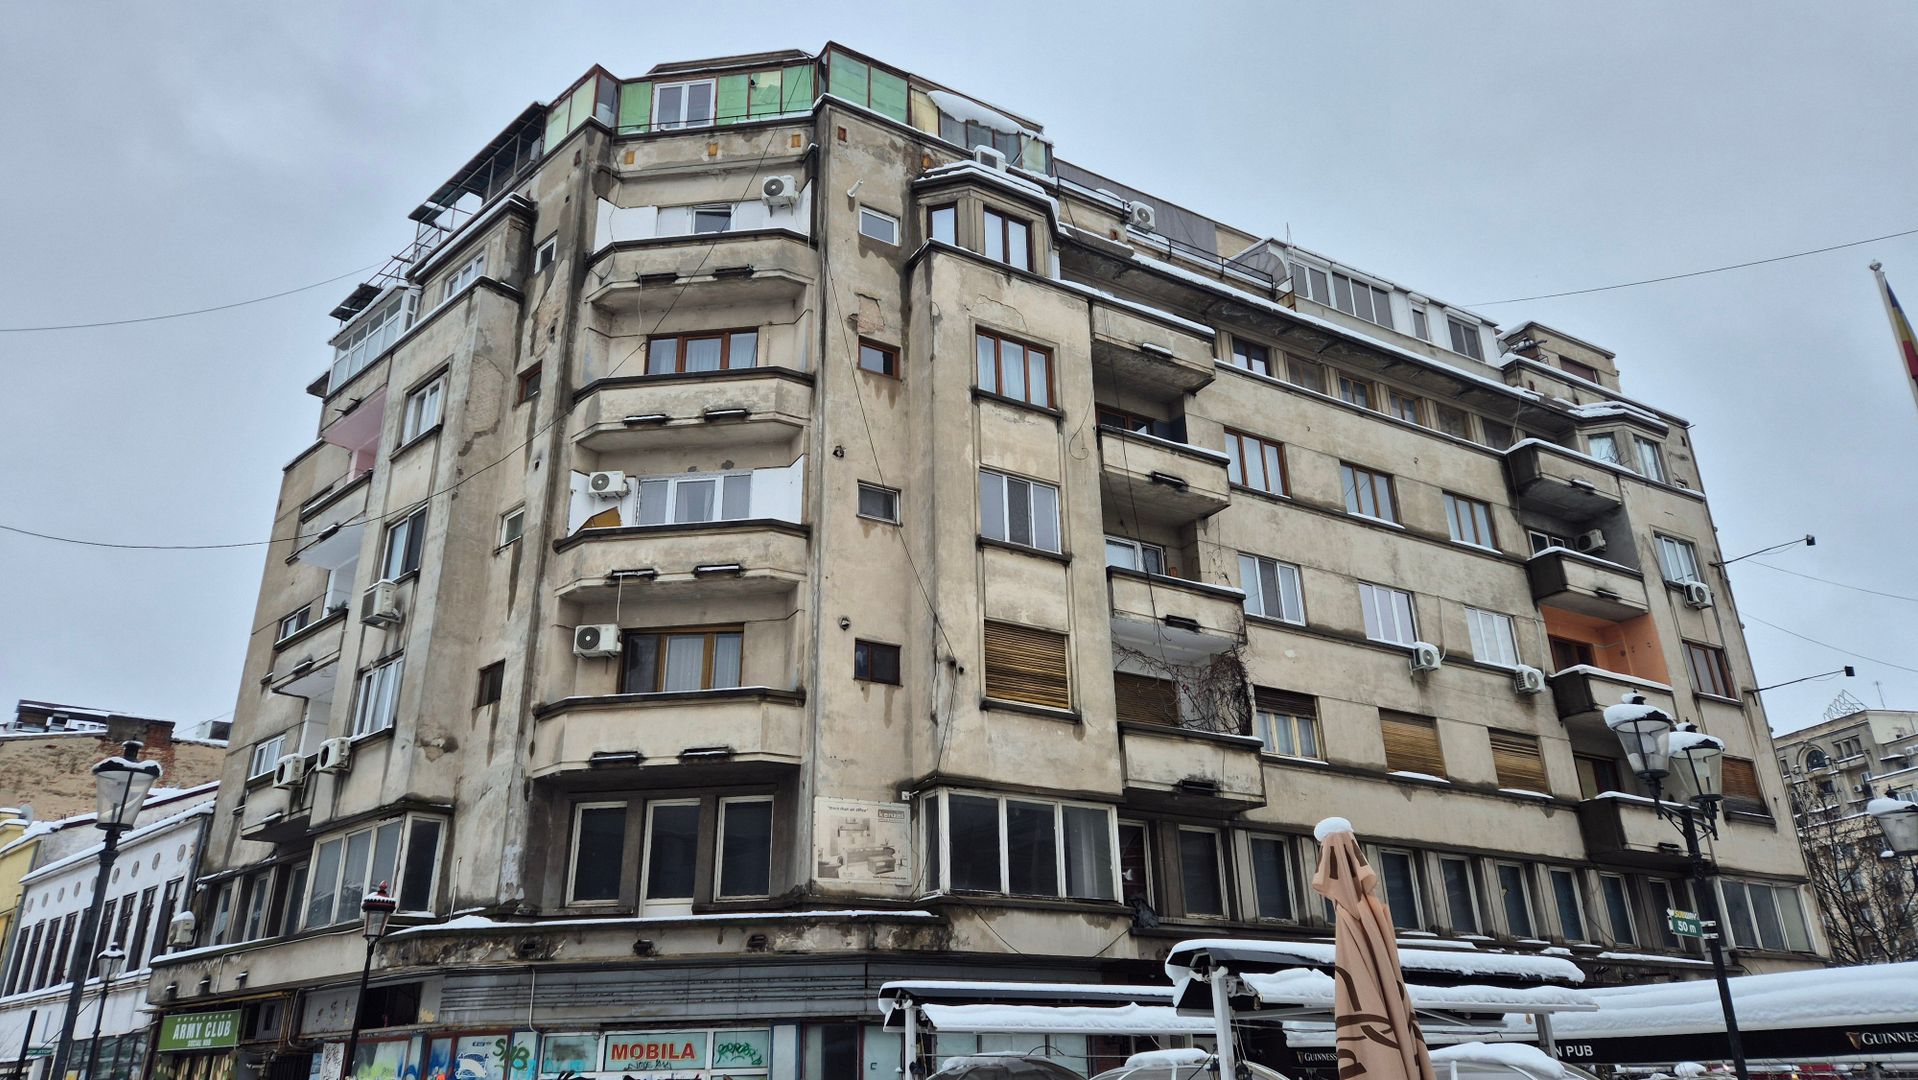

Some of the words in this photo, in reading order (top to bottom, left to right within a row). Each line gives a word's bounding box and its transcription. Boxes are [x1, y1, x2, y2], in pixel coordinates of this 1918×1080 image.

[1678, 920, 1688, 932] 50
[1690, 924, 1697, 933] m
[172, 1022, 202, 1040] ARMY
[204, 1020, 232, 1038] CLUB
[1861, 1031, 1918, 1045] GUINNES
[611, 1041, 695, 1061] MOBILA
[1304, 1052, 1338, 1062] GUINNESS
[1566, 1045, 1593, 1057] PUB
